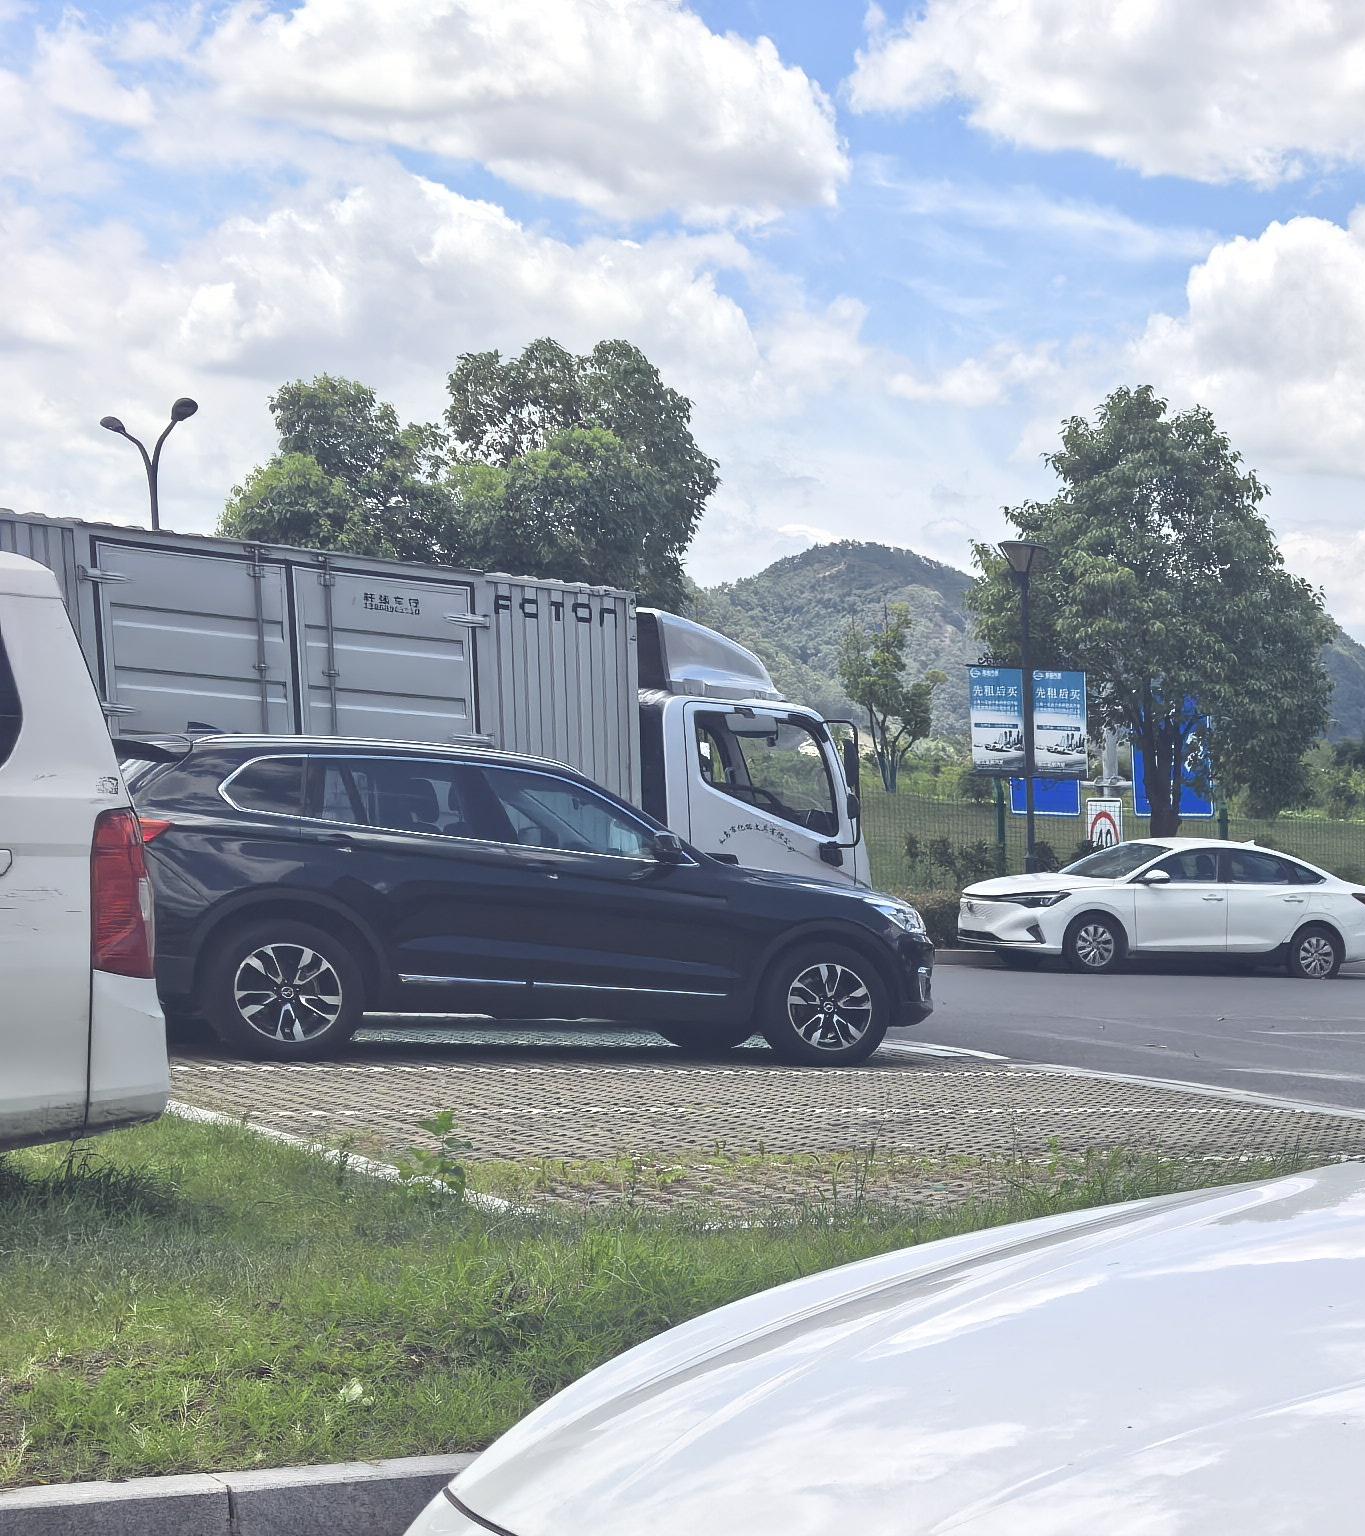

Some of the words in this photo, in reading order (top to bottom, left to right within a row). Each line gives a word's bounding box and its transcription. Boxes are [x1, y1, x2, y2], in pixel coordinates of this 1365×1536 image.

[972, 685, 1018, 697] 先租后买
[1035, 687, 1081, 700] 先租后买
